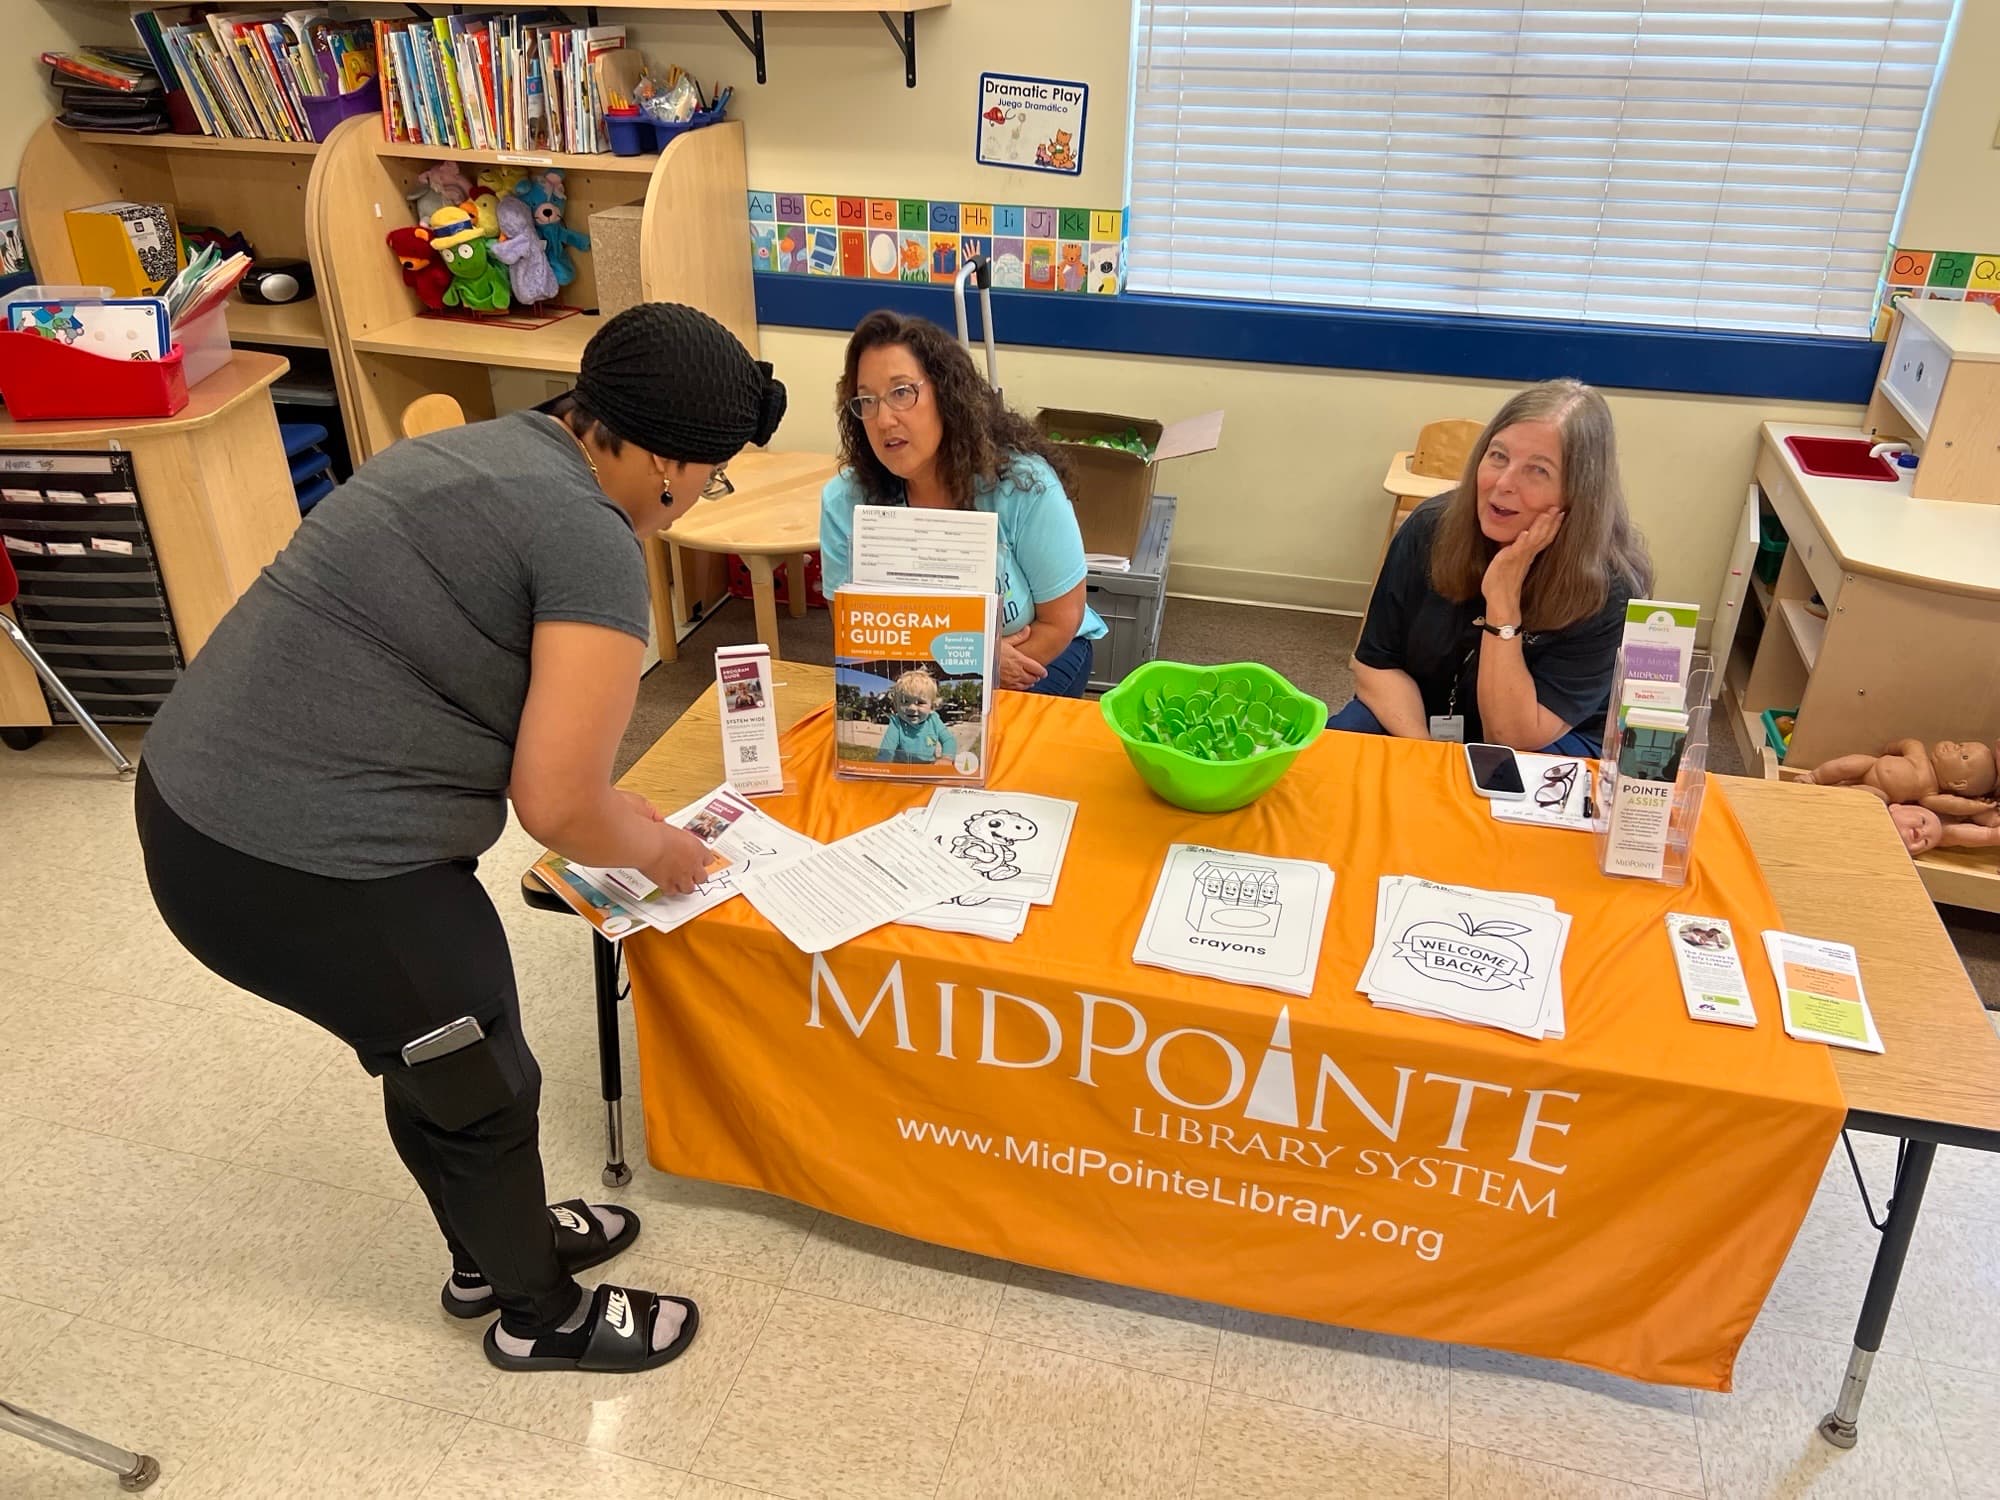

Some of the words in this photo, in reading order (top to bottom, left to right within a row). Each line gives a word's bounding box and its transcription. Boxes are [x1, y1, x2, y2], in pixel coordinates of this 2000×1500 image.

[985, 80, 1047, 99] Dramatic
[1052, 87, 1082, 105] Play
[998, 98, 1022, 109] Juego
[1025, 101, 1068, 113] Dramático
[749, 196, 773, 214] Aa
[780, 197, 802, 215] Bb
[810, 199, 832, 218] Cc
[840, 201, 862, 219] Dd
[872, 202, 893, 221] Ee
[903, 204, 924, 223] Ff
[932, 206, 957, 231] Gg
[965, 207, 988, 226] Hh
[1003, 209, 1015, 228] Ii
[1031, 211, 1052, 238] Jj
[1064, 213, 1084, 232] Kk
[1097, 215, 1114, 234] Ll
[1894, 255, 1924, 276] Oo
[1935, 257, 1964, 287] Pp
[850, 610, 951, 629] PROGRAM
[850, 628, 912, 646] GUIDE
[940, 658, 977, 667] LIBRARY!
[948, 650, 971, 659] YOUR
[1623, 784, 1669, 797] POINTE
[1627, 797, 1667, 808] ASSIST
[1188, 935, 1267, 956] crayons
[1419, 938, 1510, 969] WELCOME
[1434, 955, 1488, 977] BACK
[1133, 1107, 1344, 1169] LIBRARY
[1355, 1149, 1558, 1218] SYSTEM
[896, 1117, 1444, 1261] www.MidPointeLibrary.org
[604, 1289, 626, 1328] NIKE
